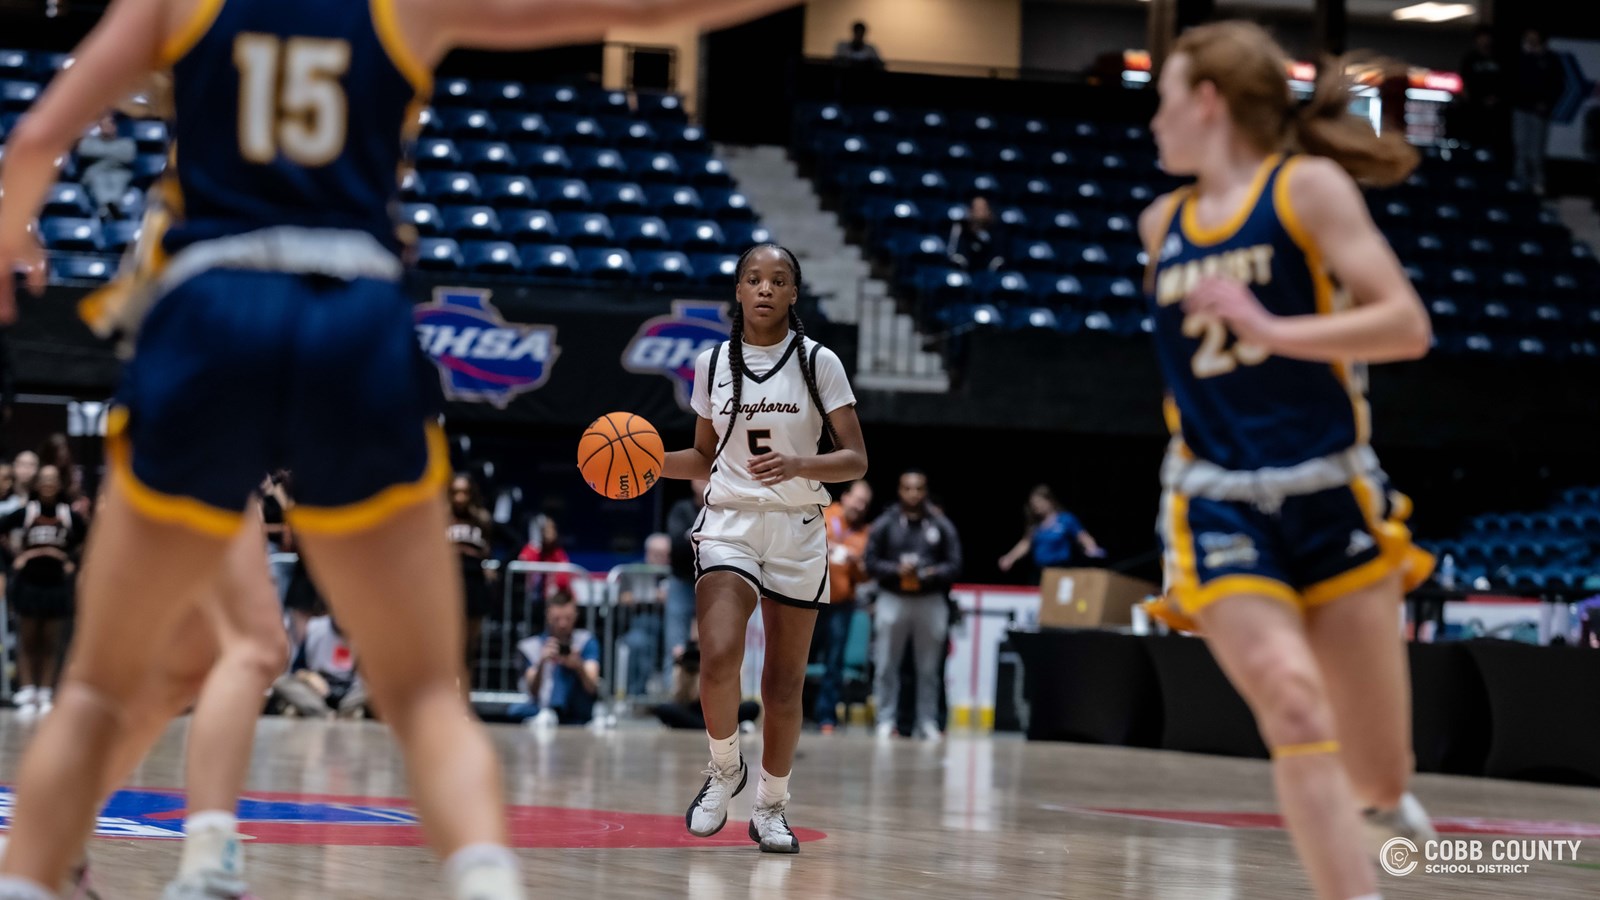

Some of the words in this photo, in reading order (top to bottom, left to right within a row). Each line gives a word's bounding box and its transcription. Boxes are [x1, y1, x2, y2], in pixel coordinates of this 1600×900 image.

[233, 31, 352, 167] 15
[630, 336, 720, 369] GH
[1182, 312, 1270, 379] 2
[747, 429, 772, 457] 5
